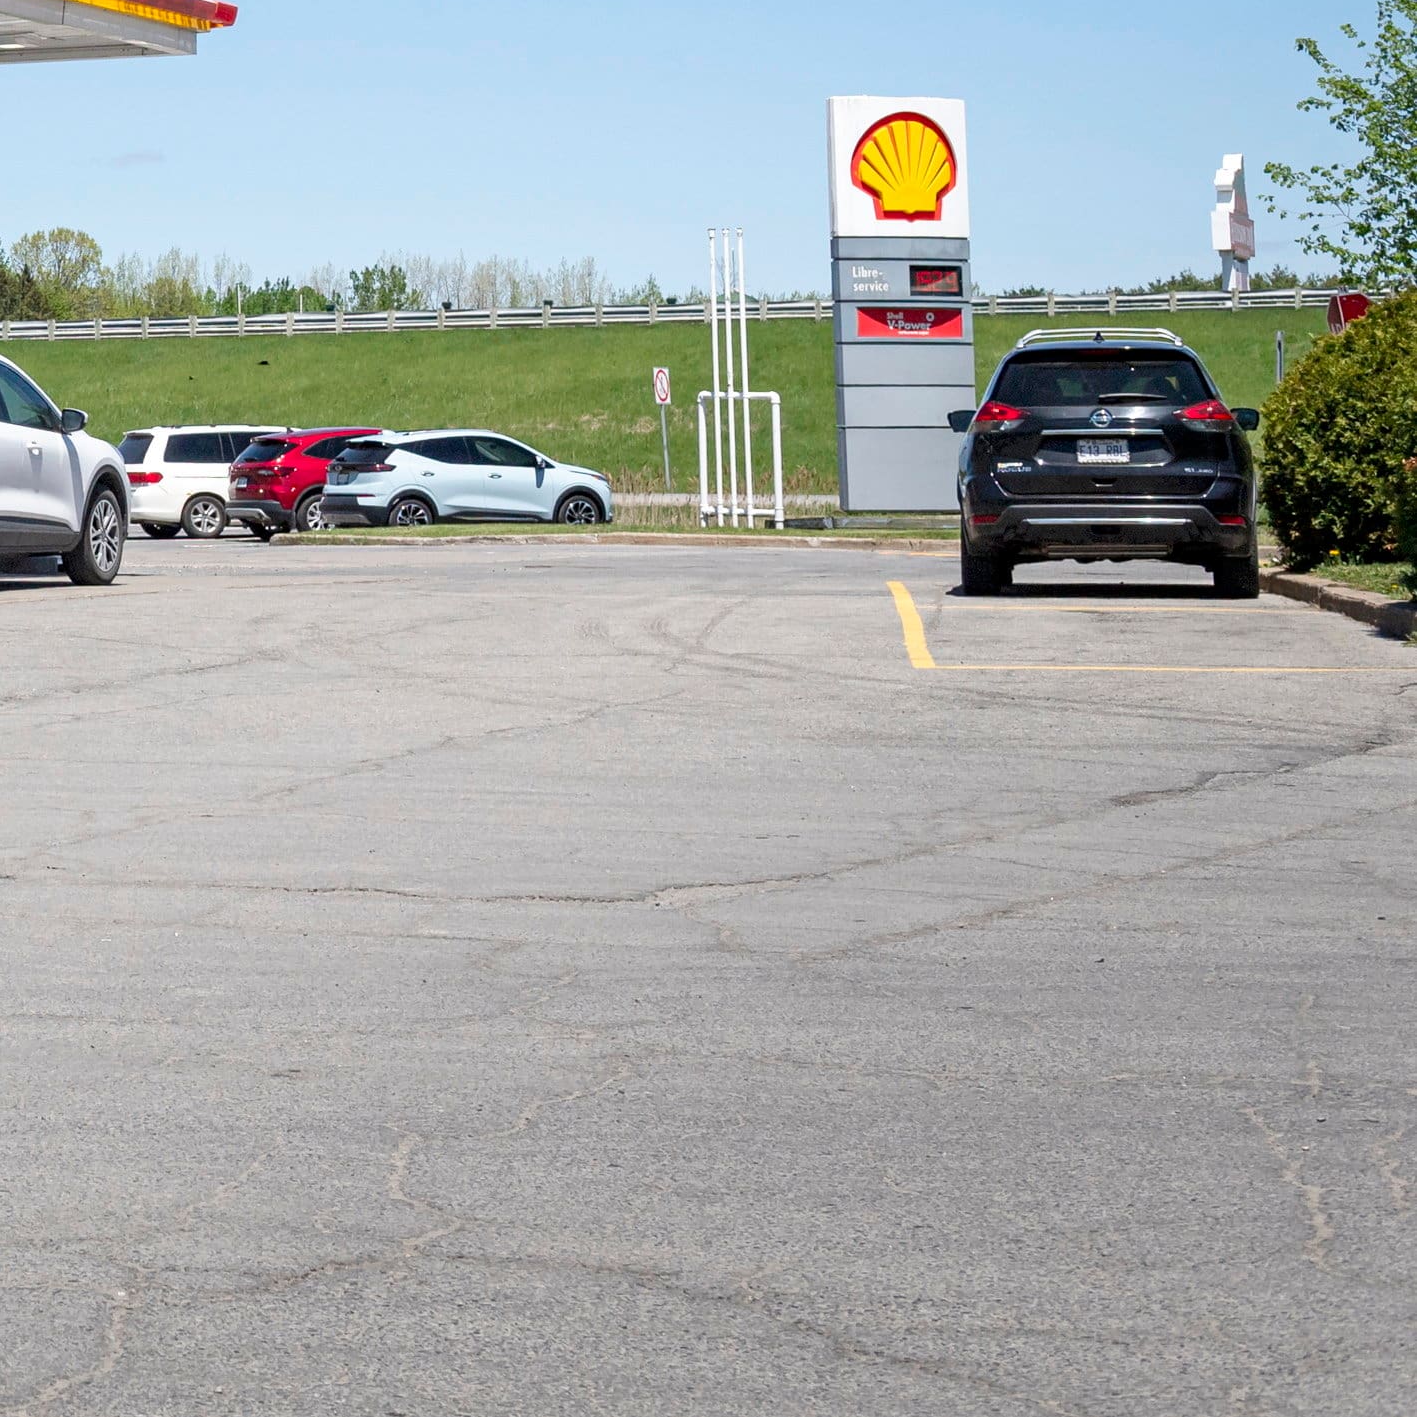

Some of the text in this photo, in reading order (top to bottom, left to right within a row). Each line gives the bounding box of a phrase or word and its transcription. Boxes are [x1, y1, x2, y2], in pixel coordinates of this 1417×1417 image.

[852, 266, 883, 278] Libre-
[853, 280, 889, 292] service
[886, 311, 904, 320] Shell
[887, 320, 932, 330] V-Power
